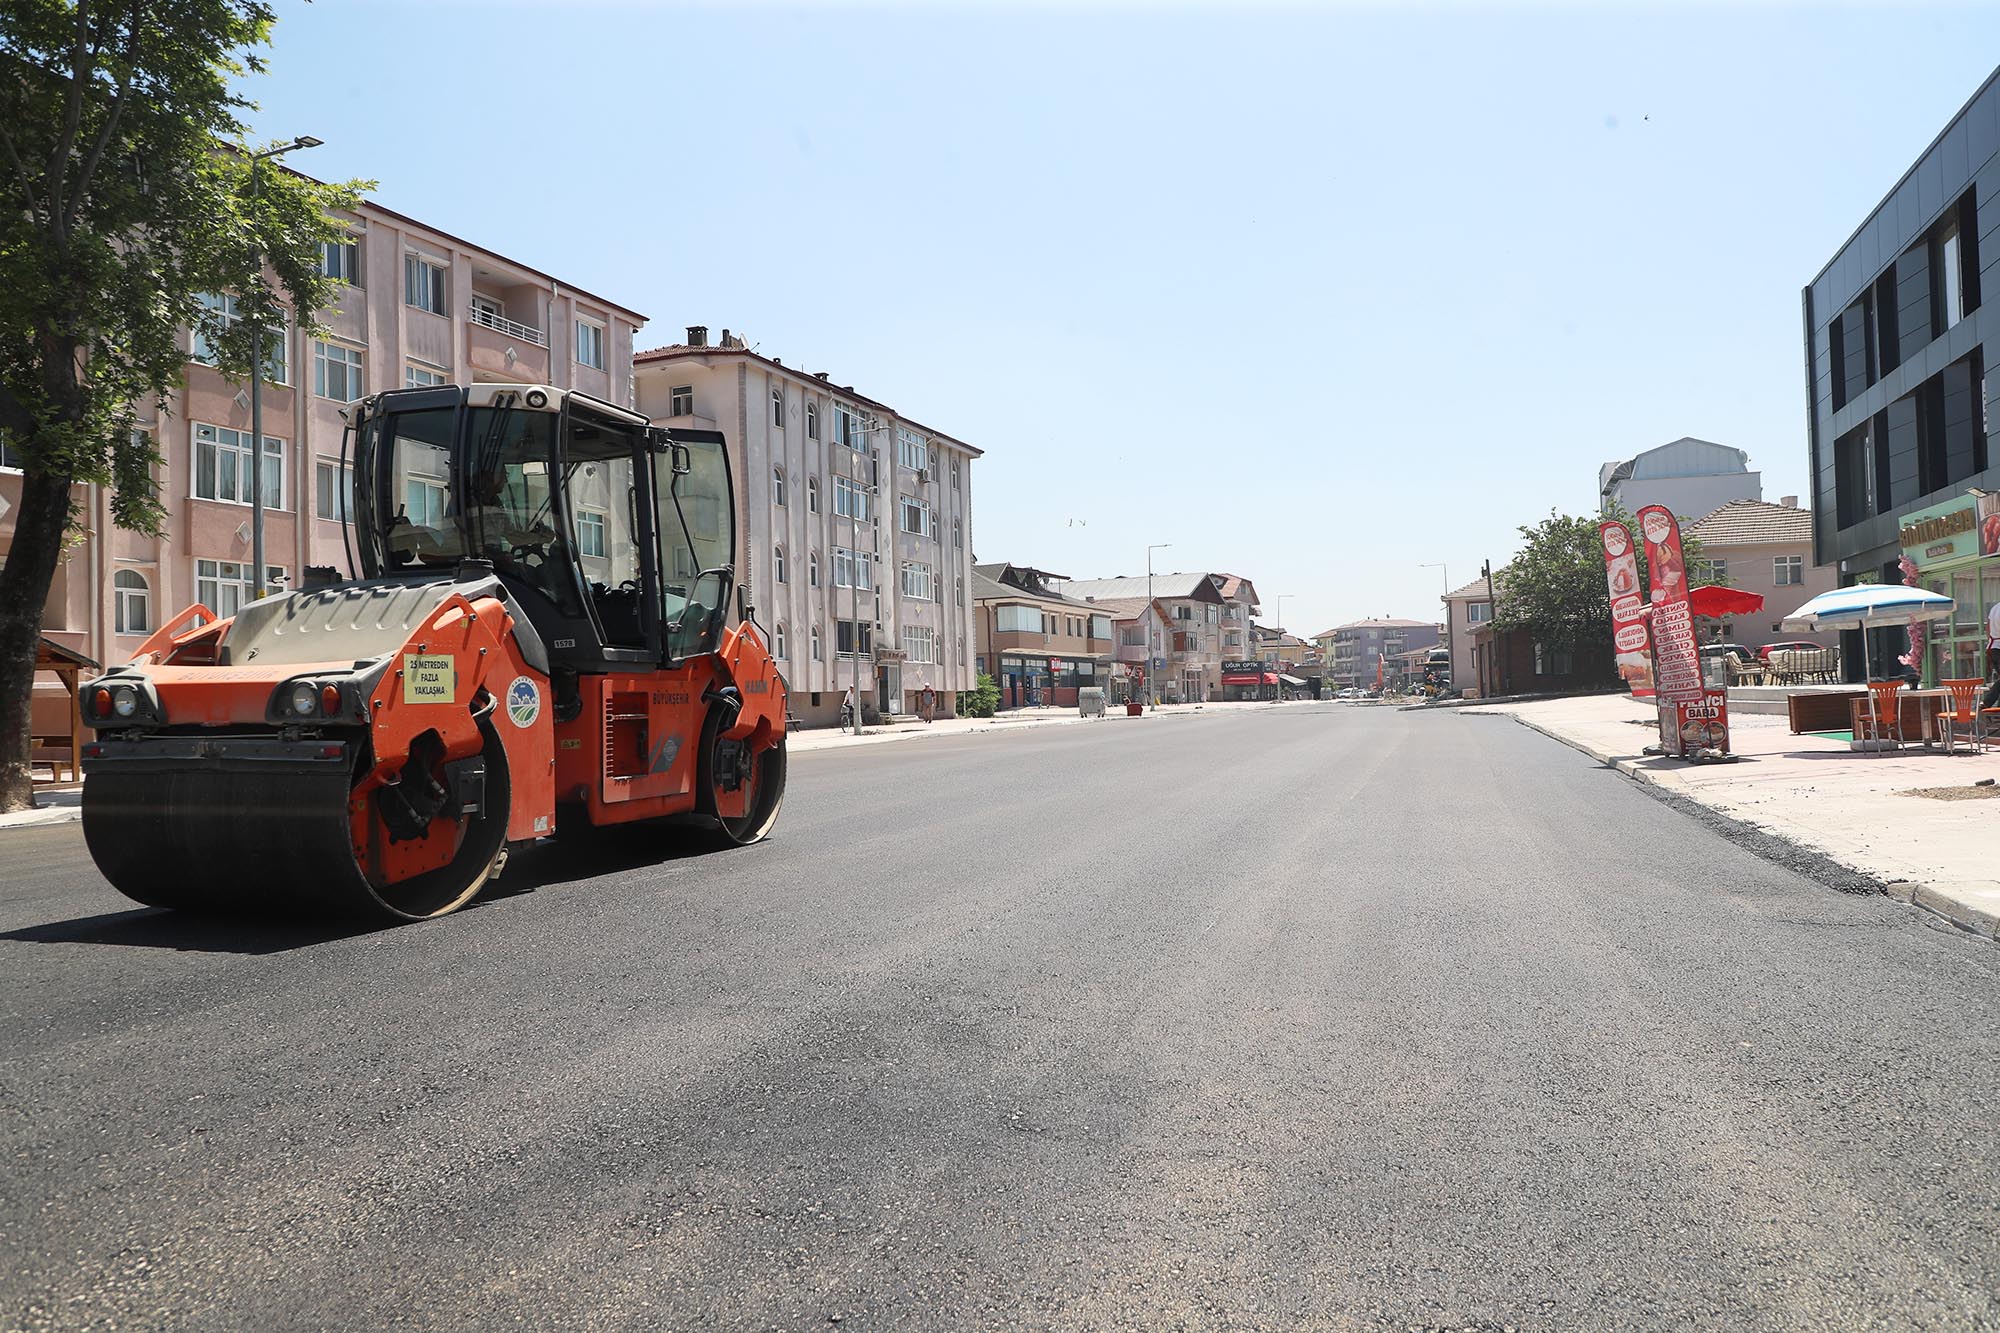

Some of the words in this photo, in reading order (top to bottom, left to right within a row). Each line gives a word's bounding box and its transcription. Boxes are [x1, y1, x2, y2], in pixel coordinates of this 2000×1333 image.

[410, 660, 418, 669] 25
[418, 660, 449, 669] METREDEN
[421, 673, 439, 682] FAZLA
[1688, 708, 1716, 718] BABA
